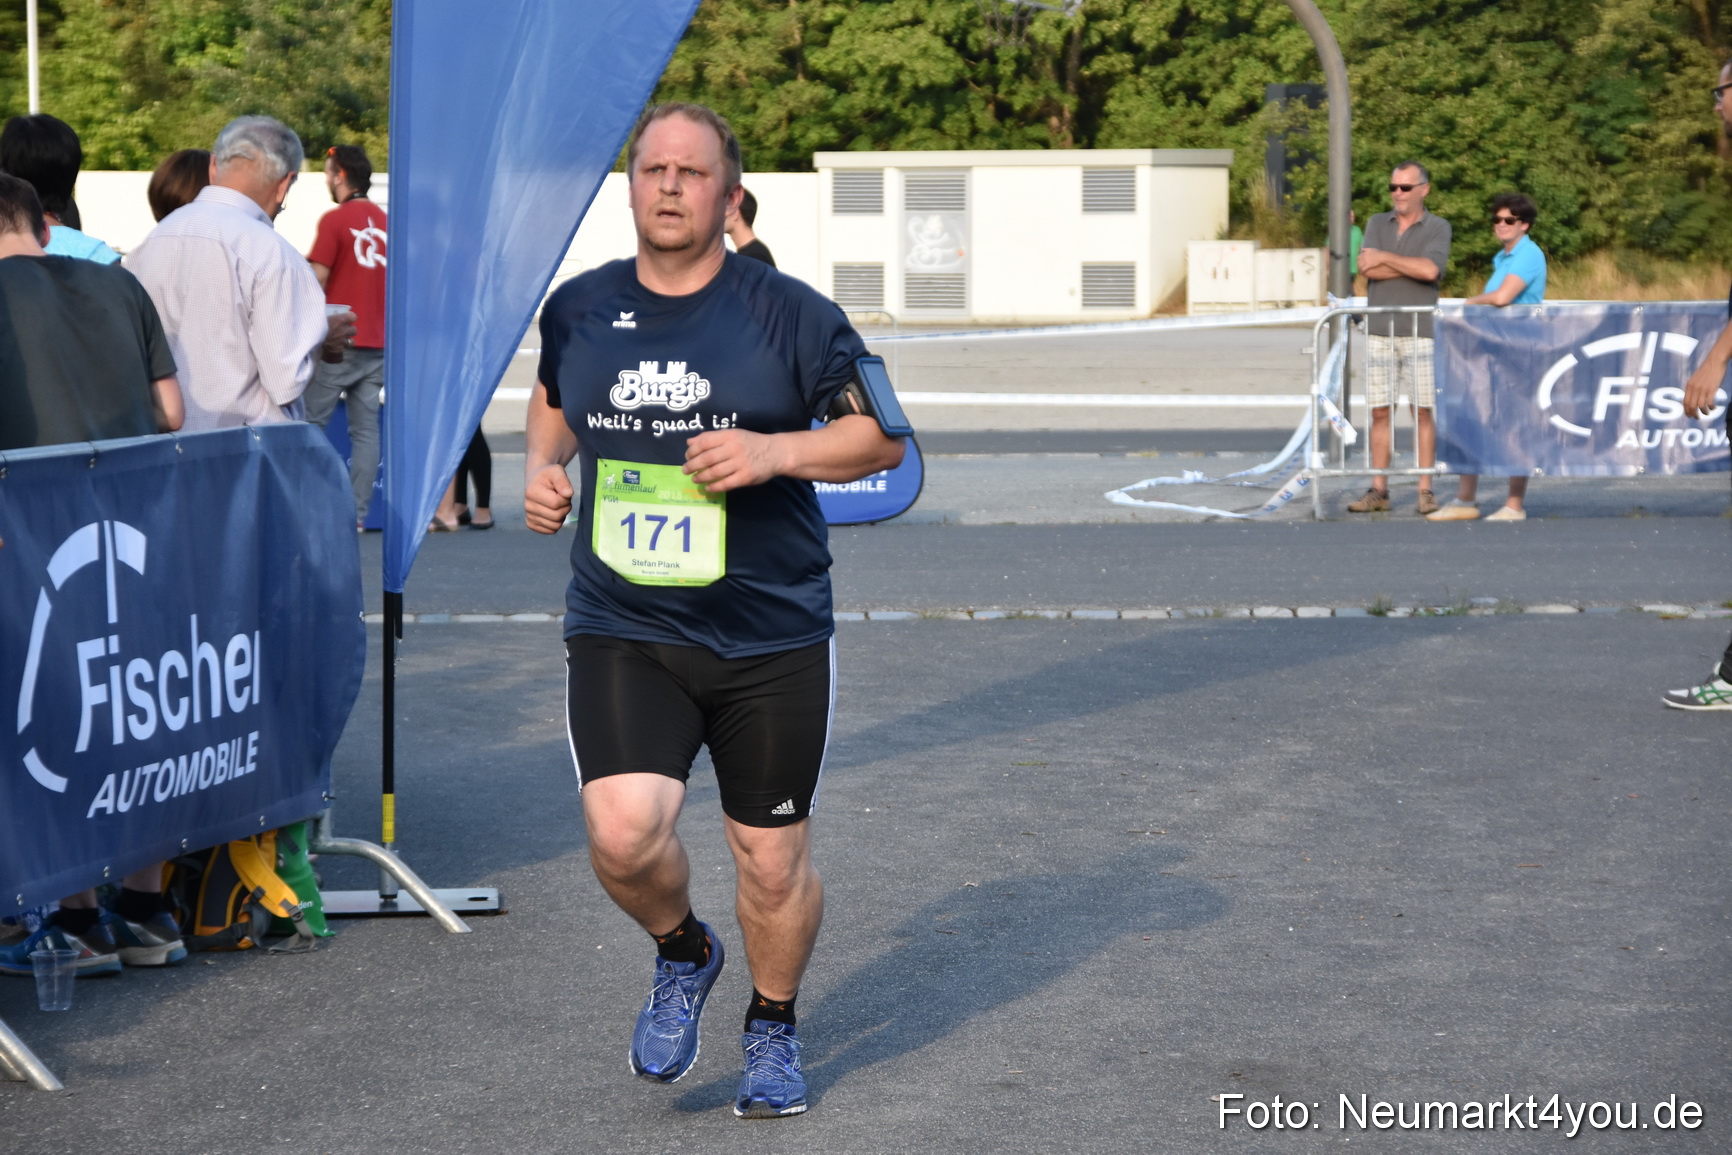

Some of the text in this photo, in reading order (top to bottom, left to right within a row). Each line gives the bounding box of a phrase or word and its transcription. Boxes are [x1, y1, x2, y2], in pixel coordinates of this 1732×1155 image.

[612, 320, 637, 328] erima
[610, 370, 711, 412] Burgis
[587, 412, 737, 437] Weil's guad is!
[620, 511, 692, 553] 171
[631, 558, 680, 569] Stefan Plank
[86, 730, 260, 819] AUTOMOBILE
